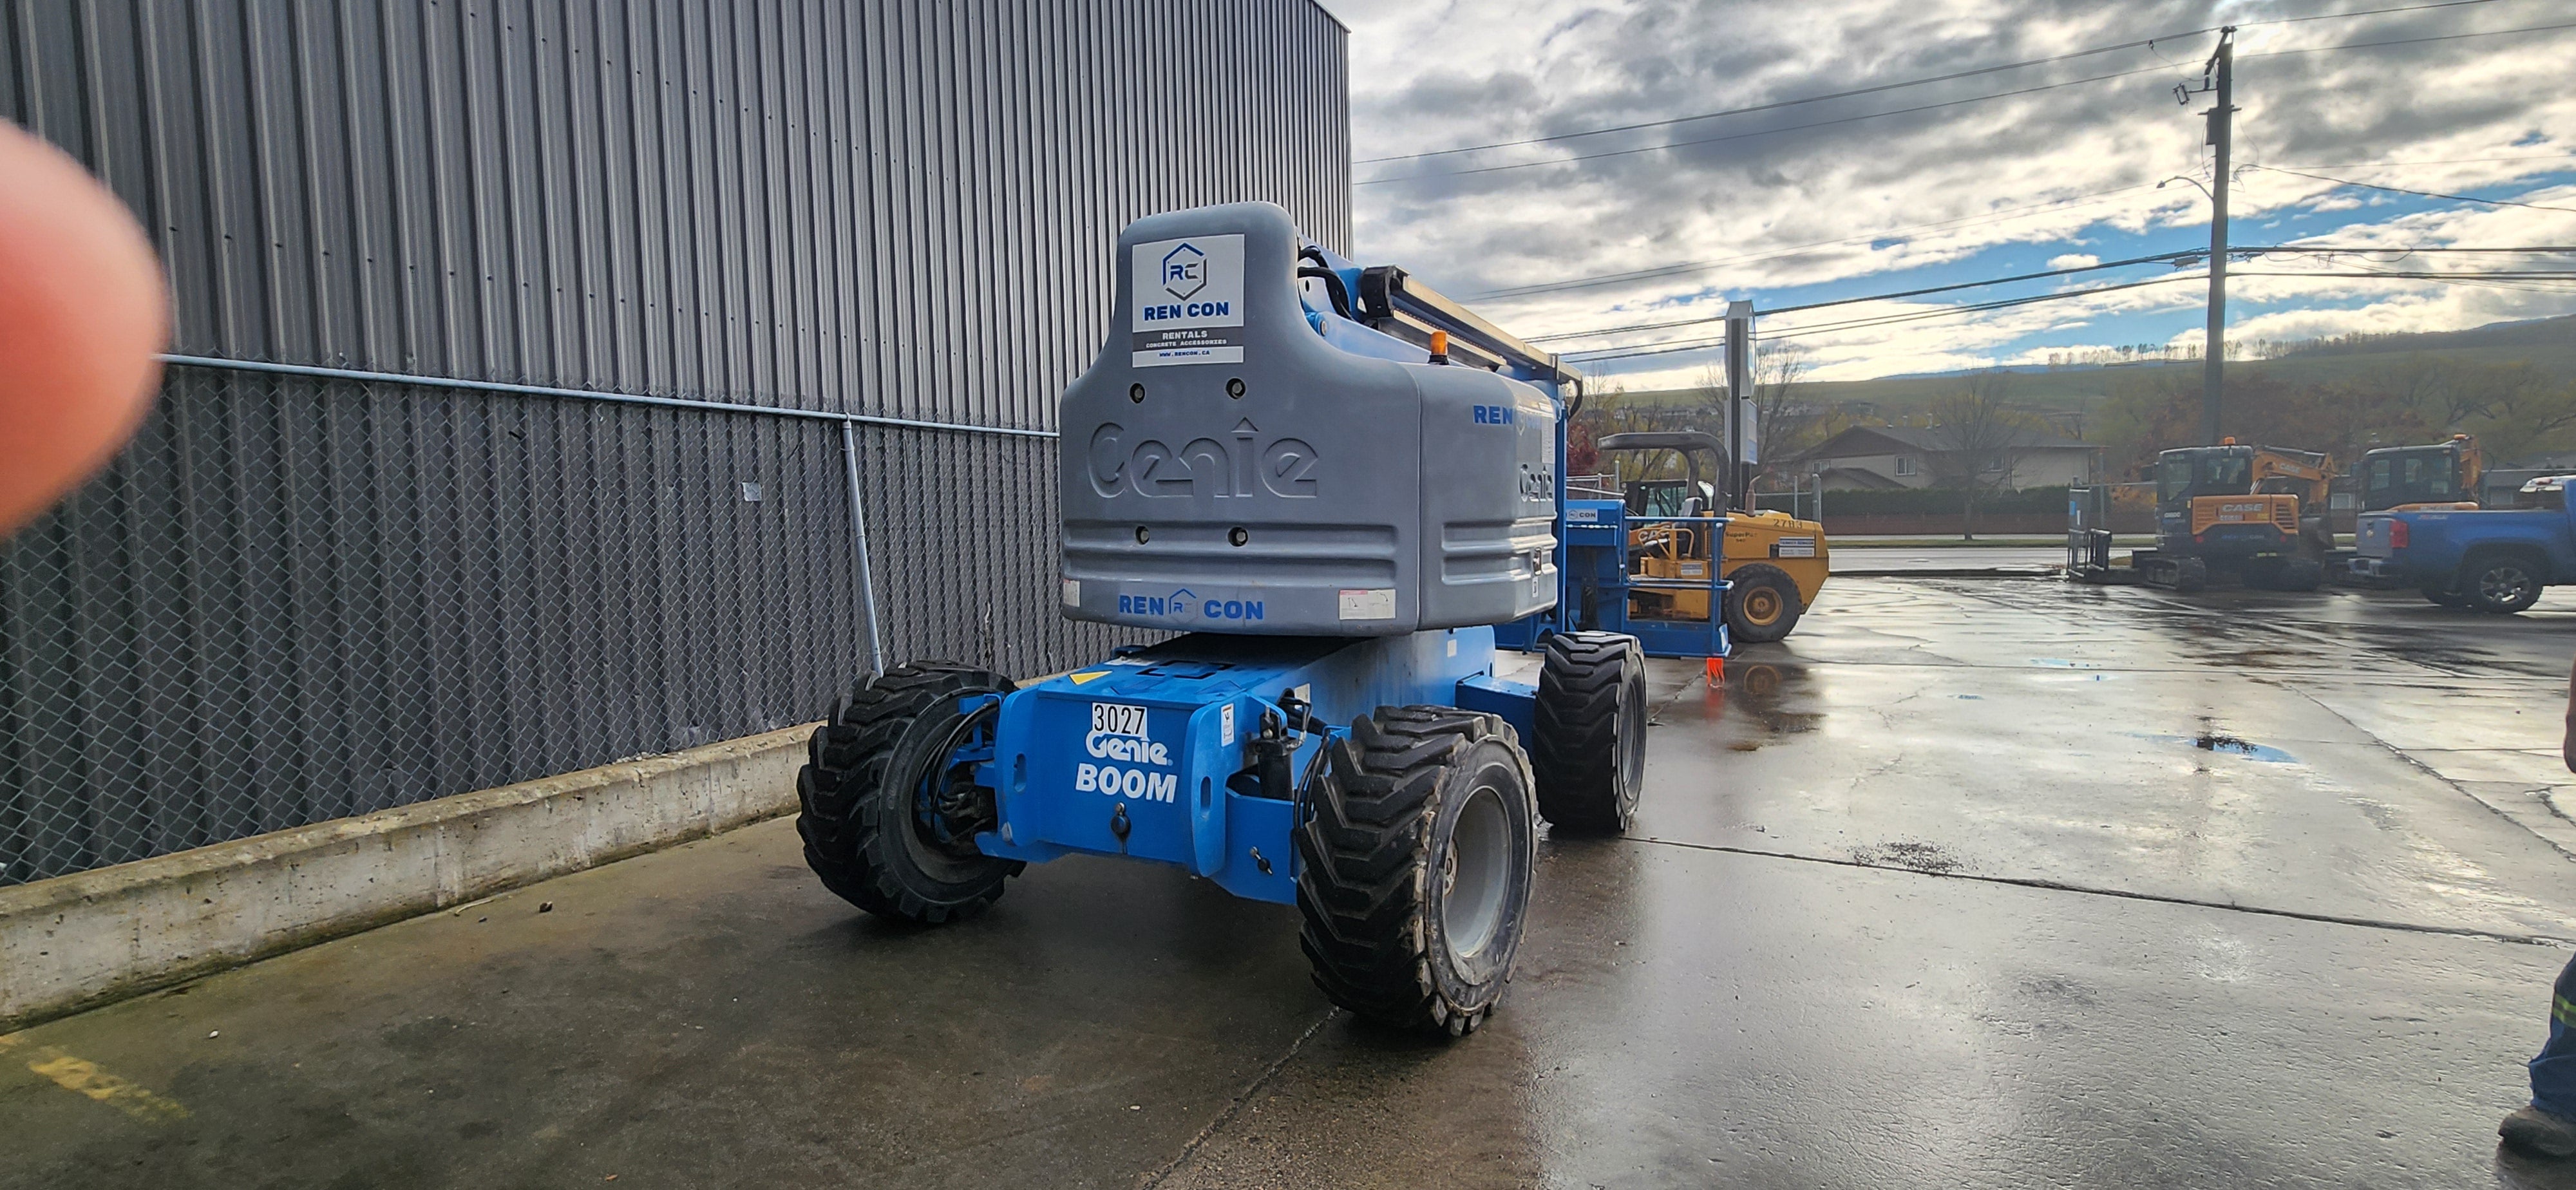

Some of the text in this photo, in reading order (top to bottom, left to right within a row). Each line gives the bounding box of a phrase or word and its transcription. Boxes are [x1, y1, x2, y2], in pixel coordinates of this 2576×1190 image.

[1170, 263, 1199, 281] RC
[1144, 301, 1229, 321] REN CON
[1162, 330, 1208, 340] RENTALS
[1473, 405, 1513, 425] REN
[1088, 416, 1318, 498] Genie
[2222, 504, 2264, 512] CASE
[1119, 594, 1164, 616] REN
[1204, 600, 1263, 619] CON
[1095, 704, 1145, 735] 3027
[1086, 730, 1169, 766] Genie
[1075, 763, 1177, 803] BOOM
